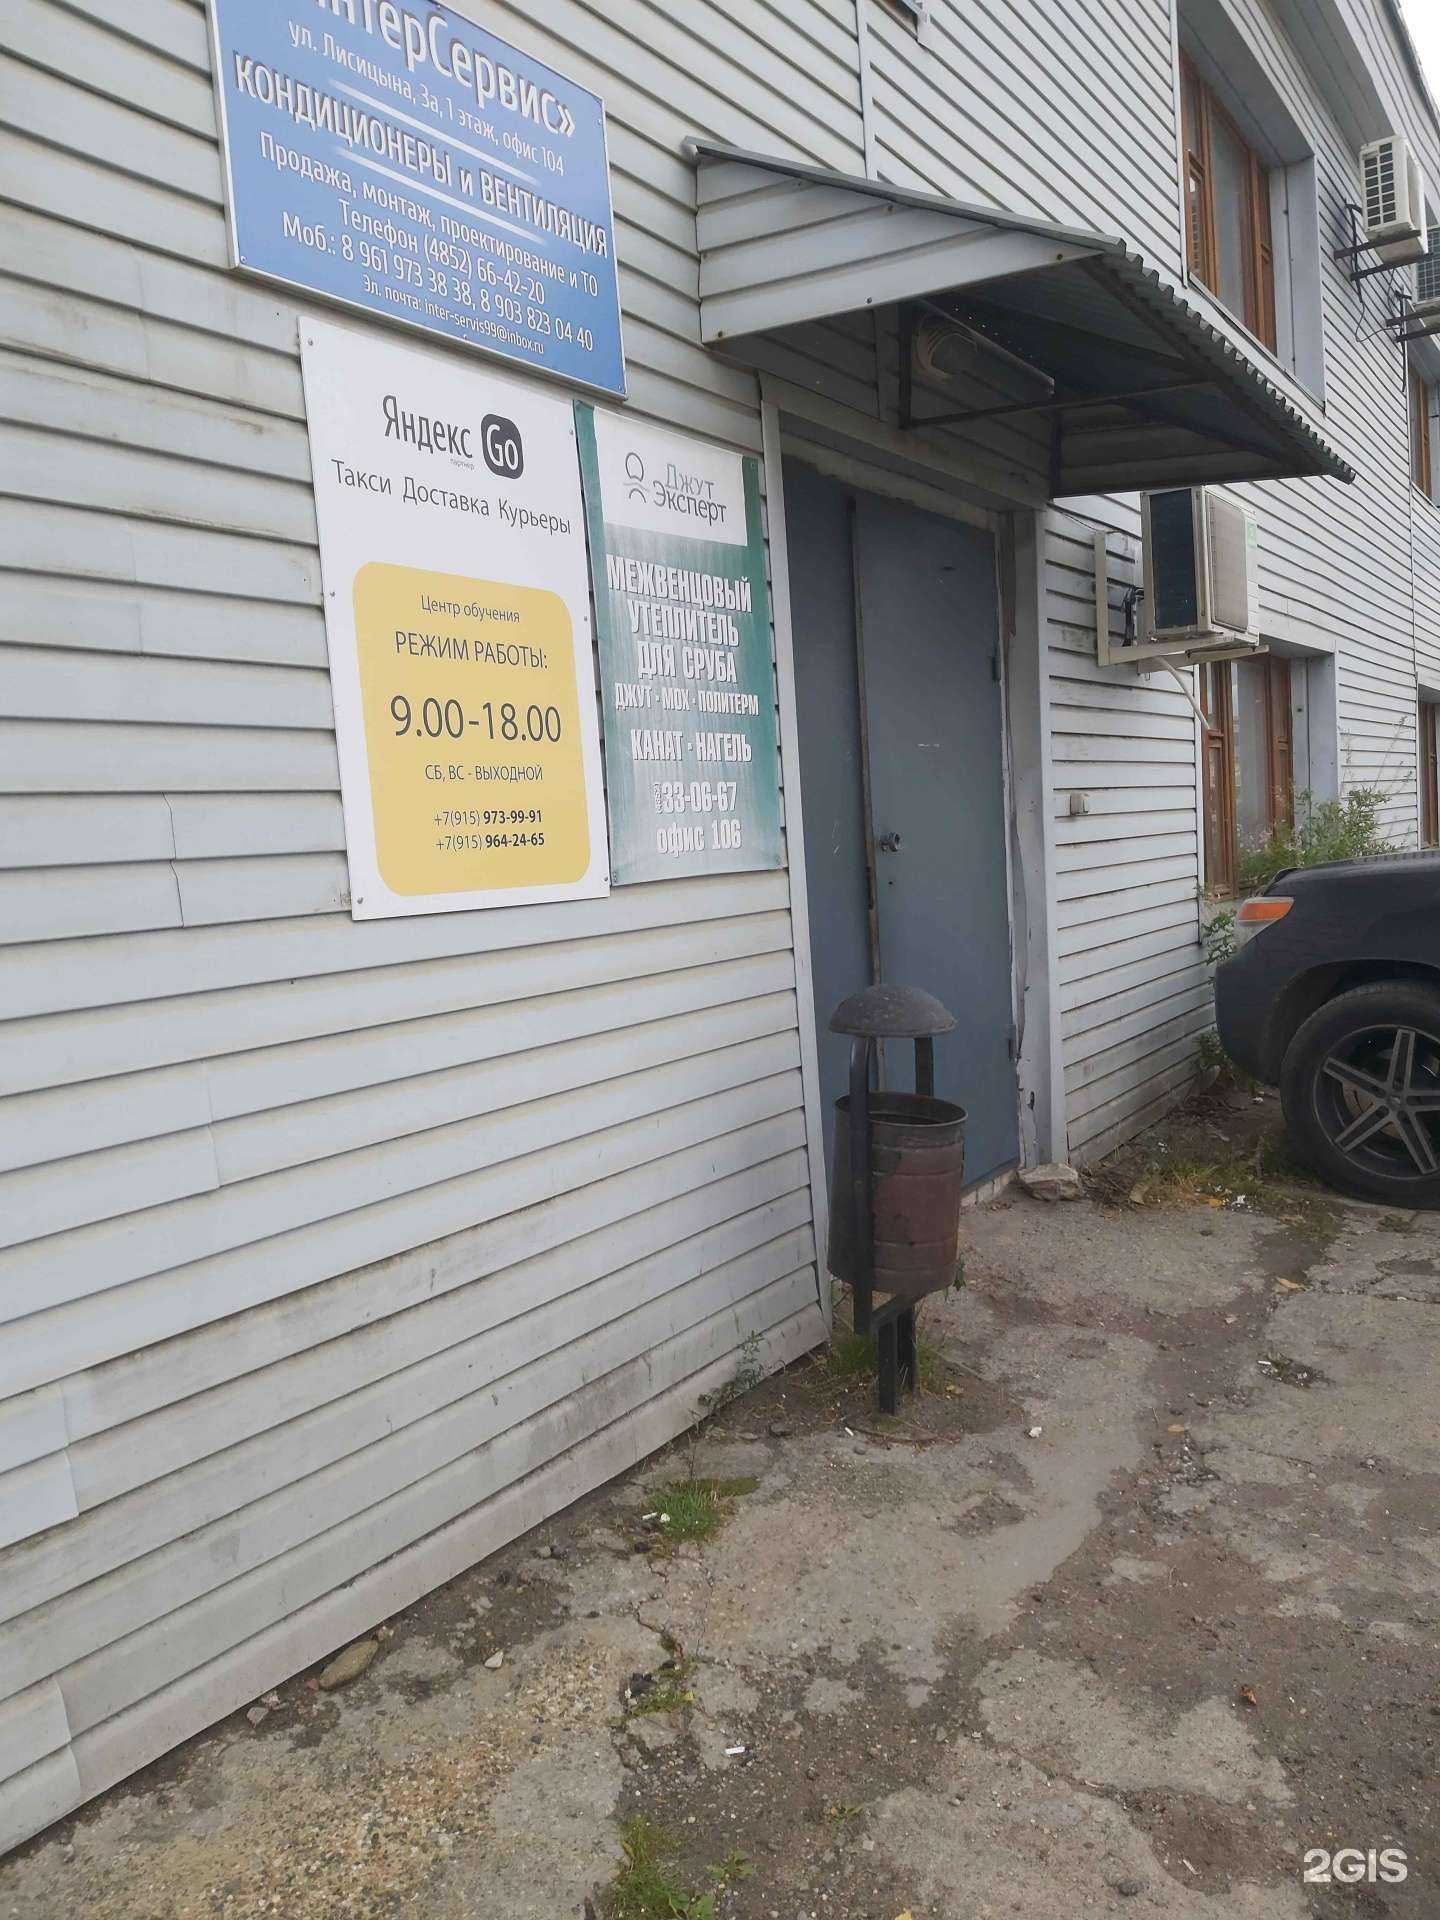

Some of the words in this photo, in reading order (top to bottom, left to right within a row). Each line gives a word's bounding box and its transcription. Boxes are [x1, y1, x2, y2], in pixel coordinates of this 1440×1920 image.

[288, 20, 317, 52] ул.
[323, 32, 416, 105] Лисицына,
[458, 109, 499, 146] этаж,
[503, 132, 540, 164] офис
[542, 147, 564, 177] 104
[235, 54, 451, 187] КОНДИЦИОНЕРЫ
[460, 169, 473, 197] и
[481, 170, 608, 259] ВЕНТИЛЯЦИЯ
[260, 131, 356, 198] Продажа,
[362, 181, 436, 232] монтаж,
[441, 215, 566, 284] проектирование
[569, 272, 578, 289] и
[580, 270, 599, 297] ТО
[338, 198, 418, 254] Телефон
[424, 233, 472, 280] (4852)
[477, 257, 545, 305] 66-42-20
[282, 211, 336, 256] Моб.:
[341, 234, 354, 261] 8
[360, 241, 388, 274] 961
[394, 255, 423, 287] 973
[427, 267, 448, 297] 38
[451, 277, 476, 310] 38,
[480, 289, 491, 313] 8
[495, 294, 523, 324] 903
[527, 306, 551, 335] 823
[555, 317, 573, 343] 04
[577, 327, 594, 351] 40
[363, 274, 381, 296] Эл.
[384, 286, 422, 311] почта:
[424, 299, 545, 354] inter-servis99@inbox.ru
[382, 394, 473, 460] Яндекс
[486, 424, 519, 471] Go
[331, 459, 392, 495] Такси
[403, 476, 490, 517] Доставка
[498, 498, 571, 535] Курьеры
[653, 480, 727, 526] Эксперт
[665, 463, 715, 499] Джут
[606, 553, 752, 613] МЕЖВЕНЦОВЫЙ
[421, 595, 461, 619] Центр
[464, 603, 520, 623] обучения
[628, 600, 740, 648] УТЕПЛИТЕЛЬ
[395, 631, 470, 661] РЕЖИМ
[475, 640, 549, 669] РАБОТЫ:
[638, 645, 676, 681] ДЛЯ
[682, 646, 738, 683] СРУБА
[390, 695, 562, 743] 9.00-18.00
[615, 683, 652, 711] ДЖУТ
[662, 687, 691, 711] МОХ
[698, 690, 760, 716] ПОЛИТЕРМ
[630, 729, 683, 761] КАНАТ
[695, 731, 752, 762] НАГЕЛЬ
[425, 764, 446, 782] СБ,
[448, 764, 464, 780] ВС
[475, 763, 543, 782] ВЫХОДНОЙ
[434, 809, 481, 827] +7(915)
[484, 809, 543, 825] 973-99-91
[662, 781, 737, 813] 33-06-67
[436, 833, 483, 850] +7(915)
[485, 832, 545, 848] 964-24-65
[656, 821, 705, 857] офис
[711, 819, 742, 850] 106
